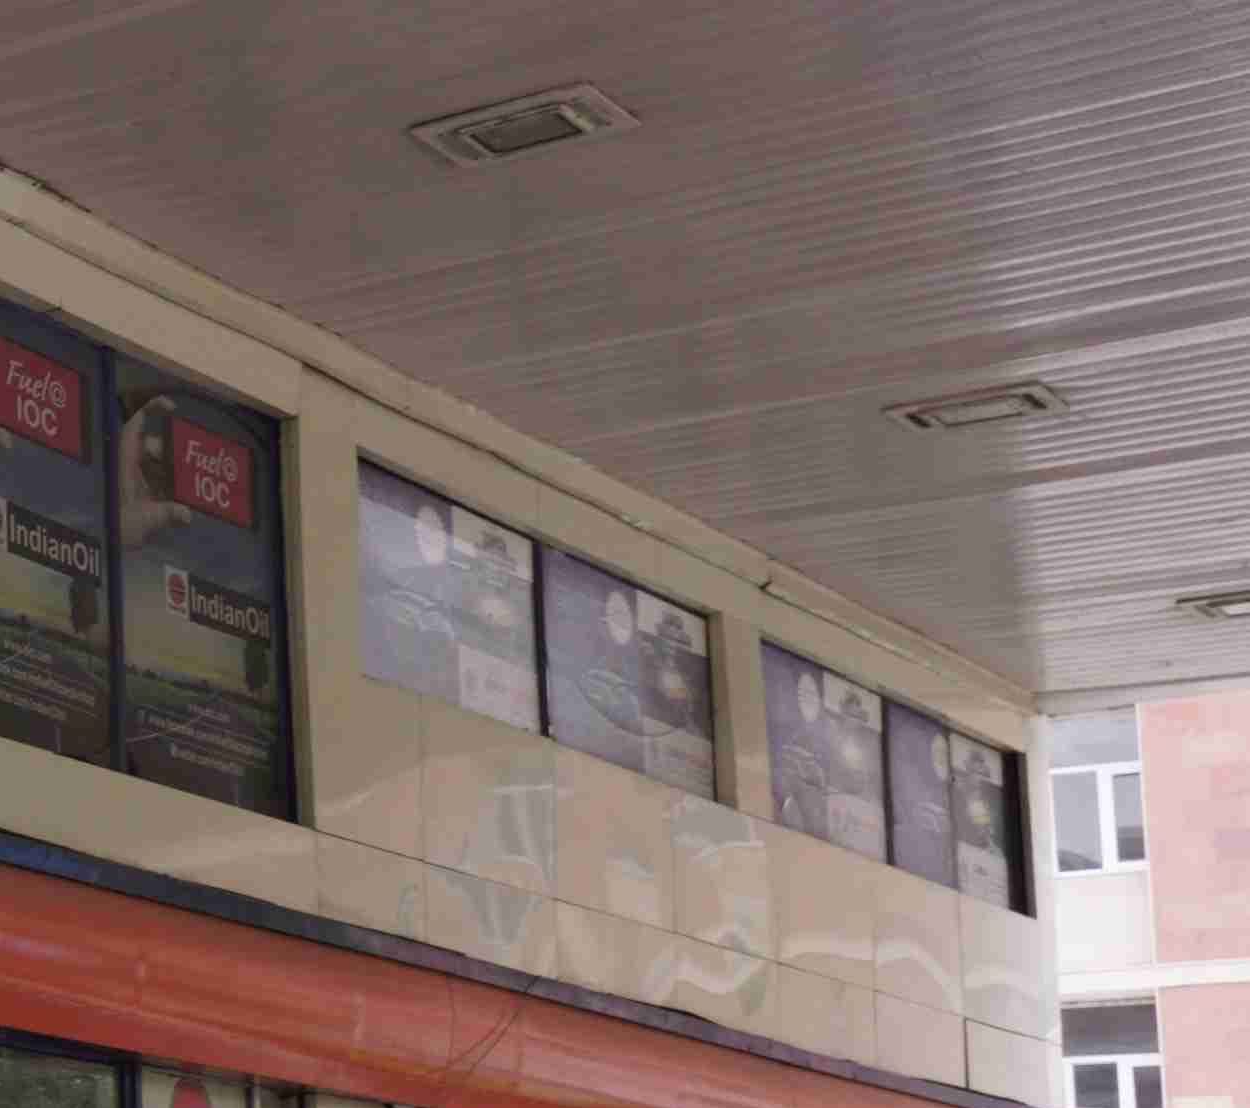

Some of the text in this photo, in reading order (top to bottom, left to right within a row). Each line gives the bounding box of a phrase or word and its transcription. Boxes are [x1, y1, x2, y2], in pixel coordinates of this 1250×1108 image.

[16, 399, 59, 437] IOC
[195, 475, 230, 509] IOC
[10, 514, 100, 577] IndianOil
[190, 588, 269, 637] IndianOil
